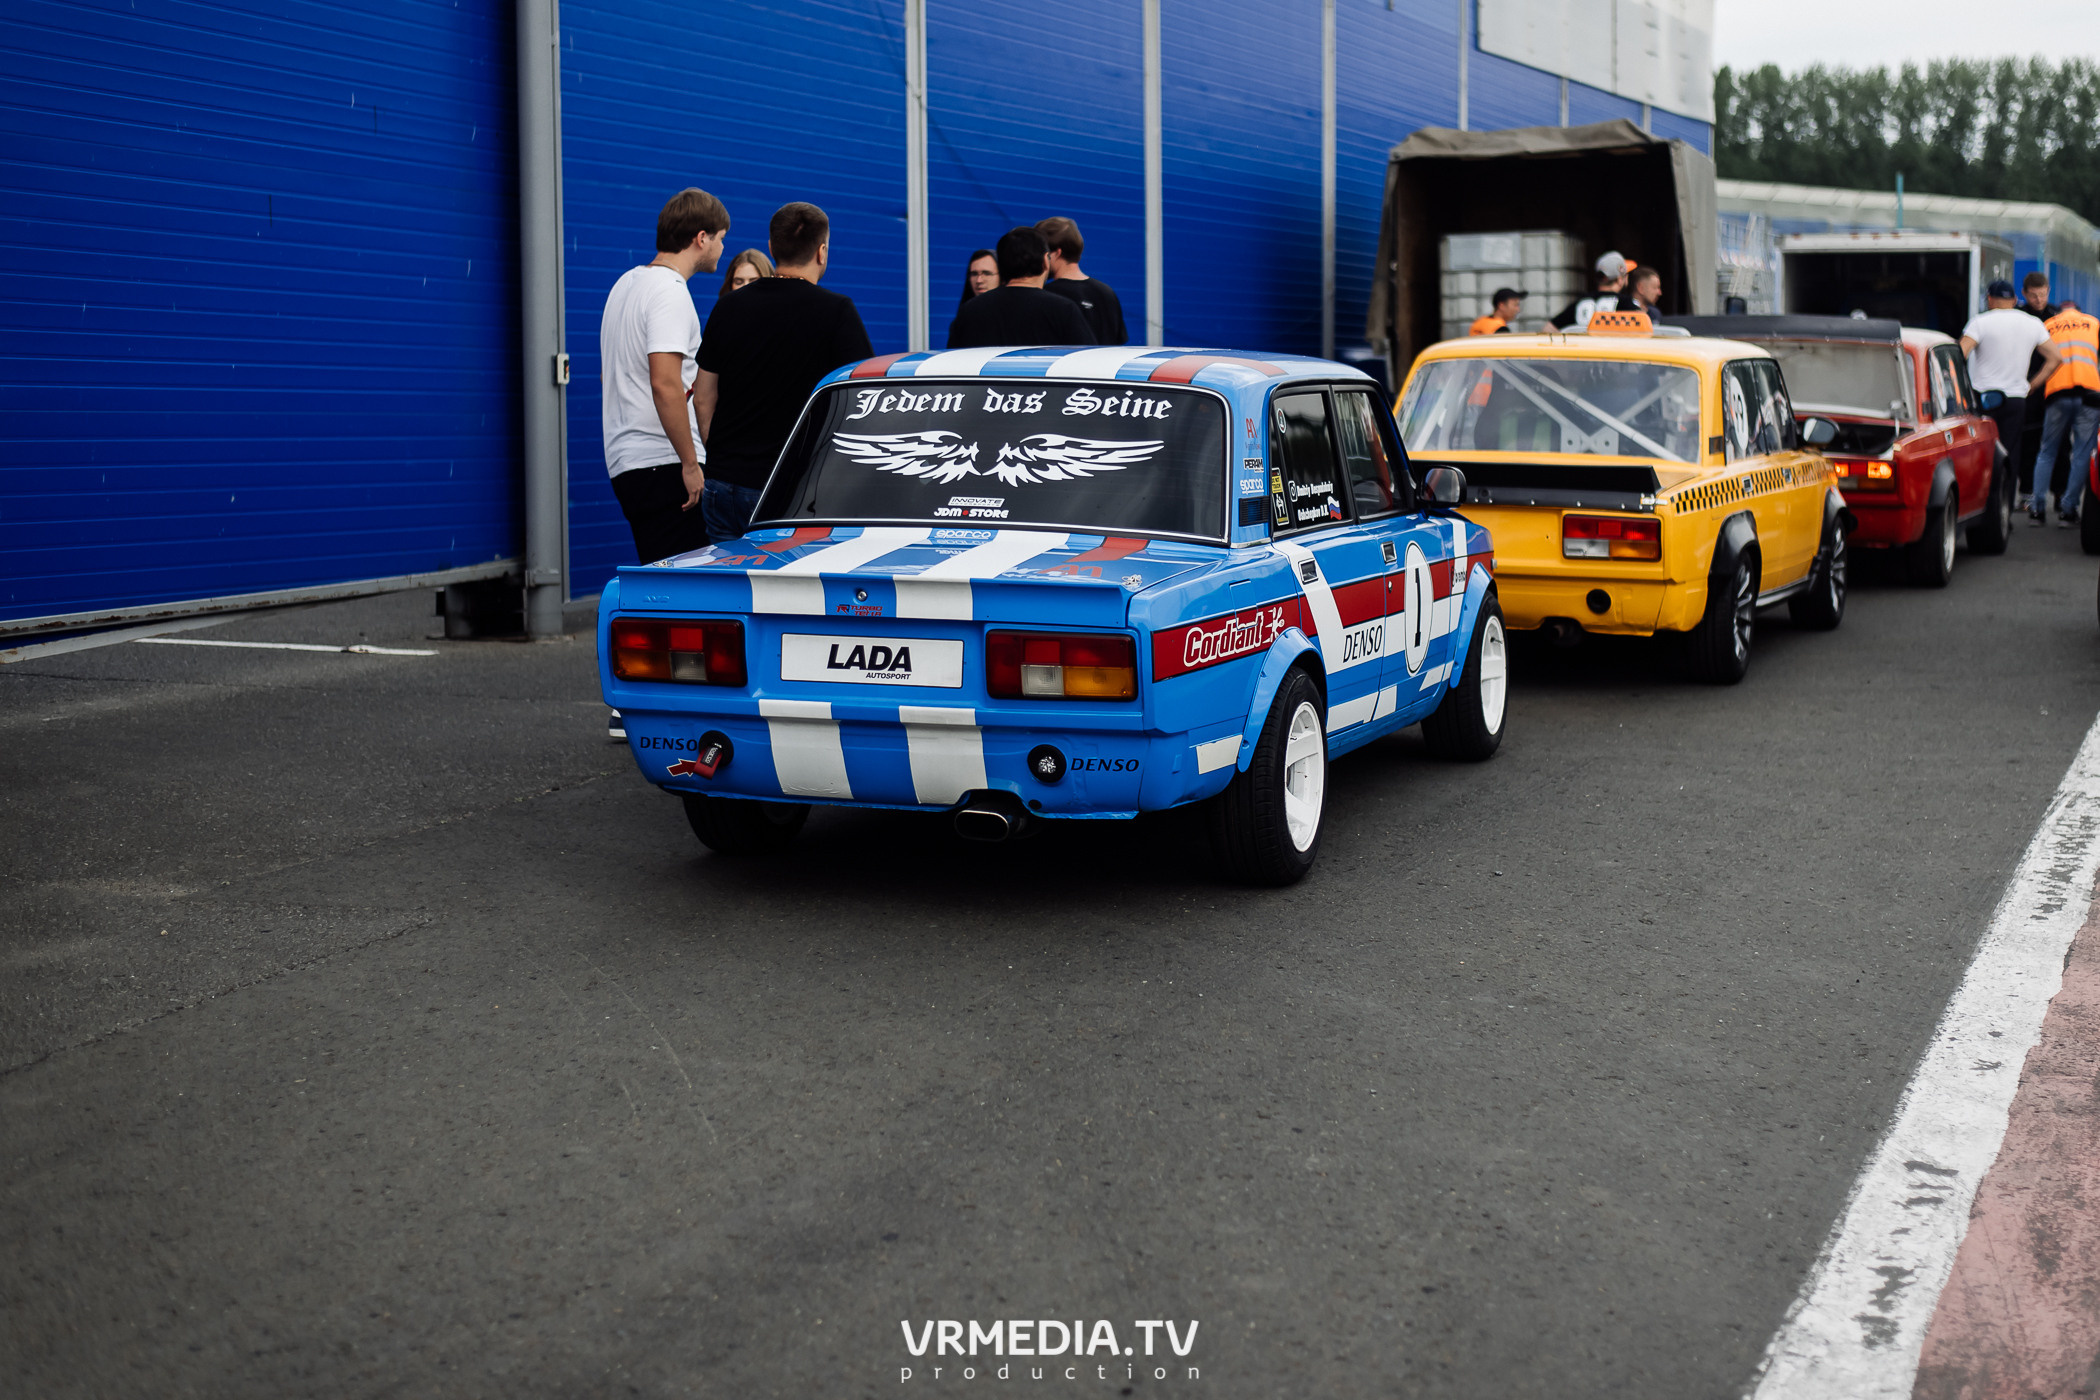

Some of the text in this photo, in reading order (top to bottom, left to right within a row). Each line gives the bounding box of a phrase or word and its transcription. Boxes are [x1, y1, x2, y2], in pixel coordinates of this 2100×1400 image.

[846, 388, 1173, 421] Jedem das Seine
[1240, 479, 1264, 495] sparco
[935, 530, 991, 540] sparco
[1414, 567, 1421, 648] 1
[1183, 611, 1264, 668] Cordiant
[1343, 624, 1383, 663] DENSO
[827, 644, 912, 672] LADA
[866, 672, 911, 680] AUTOSPORT
[640, 736, 698, 752] DENSO
[1070, 757, 1139, 772] DENSO
